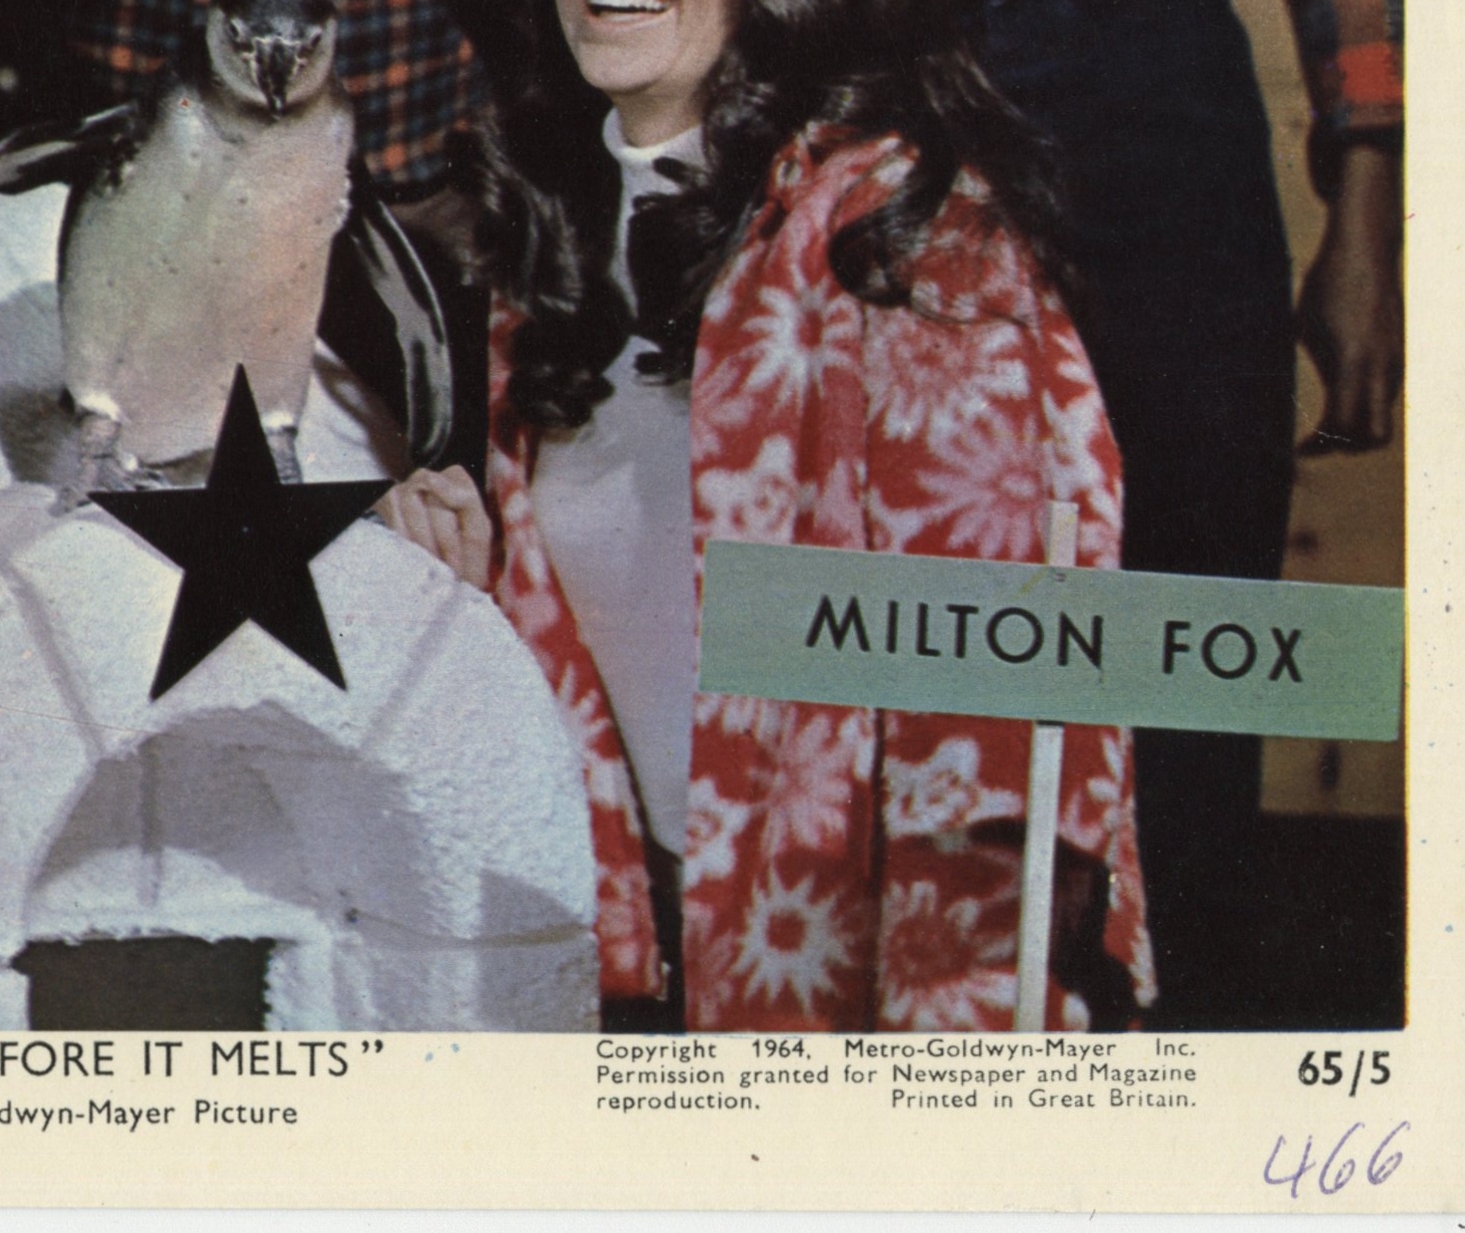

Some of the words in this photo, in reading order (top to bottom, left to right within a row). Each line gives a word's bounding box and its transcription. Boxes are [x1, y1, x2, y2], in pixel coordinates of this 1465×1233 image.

[805, 593, 1104, 671] MILTON
[1162, 619, 1303, 685] FOX
[143, 1040, 184, 1078] IT
[596, 1038, 717, 1064] Copyright
[844, 1037, 1117, 1062] Metro-Goldwyn-Mayer
[1155, 1037, 1196, 1057] Inc.
[596, 1064, 725, 1085] Permission
[739, 1064, 829, 1089] granted
[843, 1064, 878, 1084] for
[892, 1063, 1026, 1087] Newspaper
[1037, 1063, 1078, 1083] and
[1089, 1062, 1197, 1087] Magazine
[1297, 1049, 1391, 1098] 65/5
[194, 1099, 298, 1125] Picture
[596, 1090, 760, 1114] reproduction.
[891, 1088, 978, 1109] Printed
[993, 1089, 1014, 1108] in
[1028, 1088, 1096, 1108] Great
[1110, 1087, 1196, 1108] Britain.
[1262, 1119, 1412, 1200] 466
